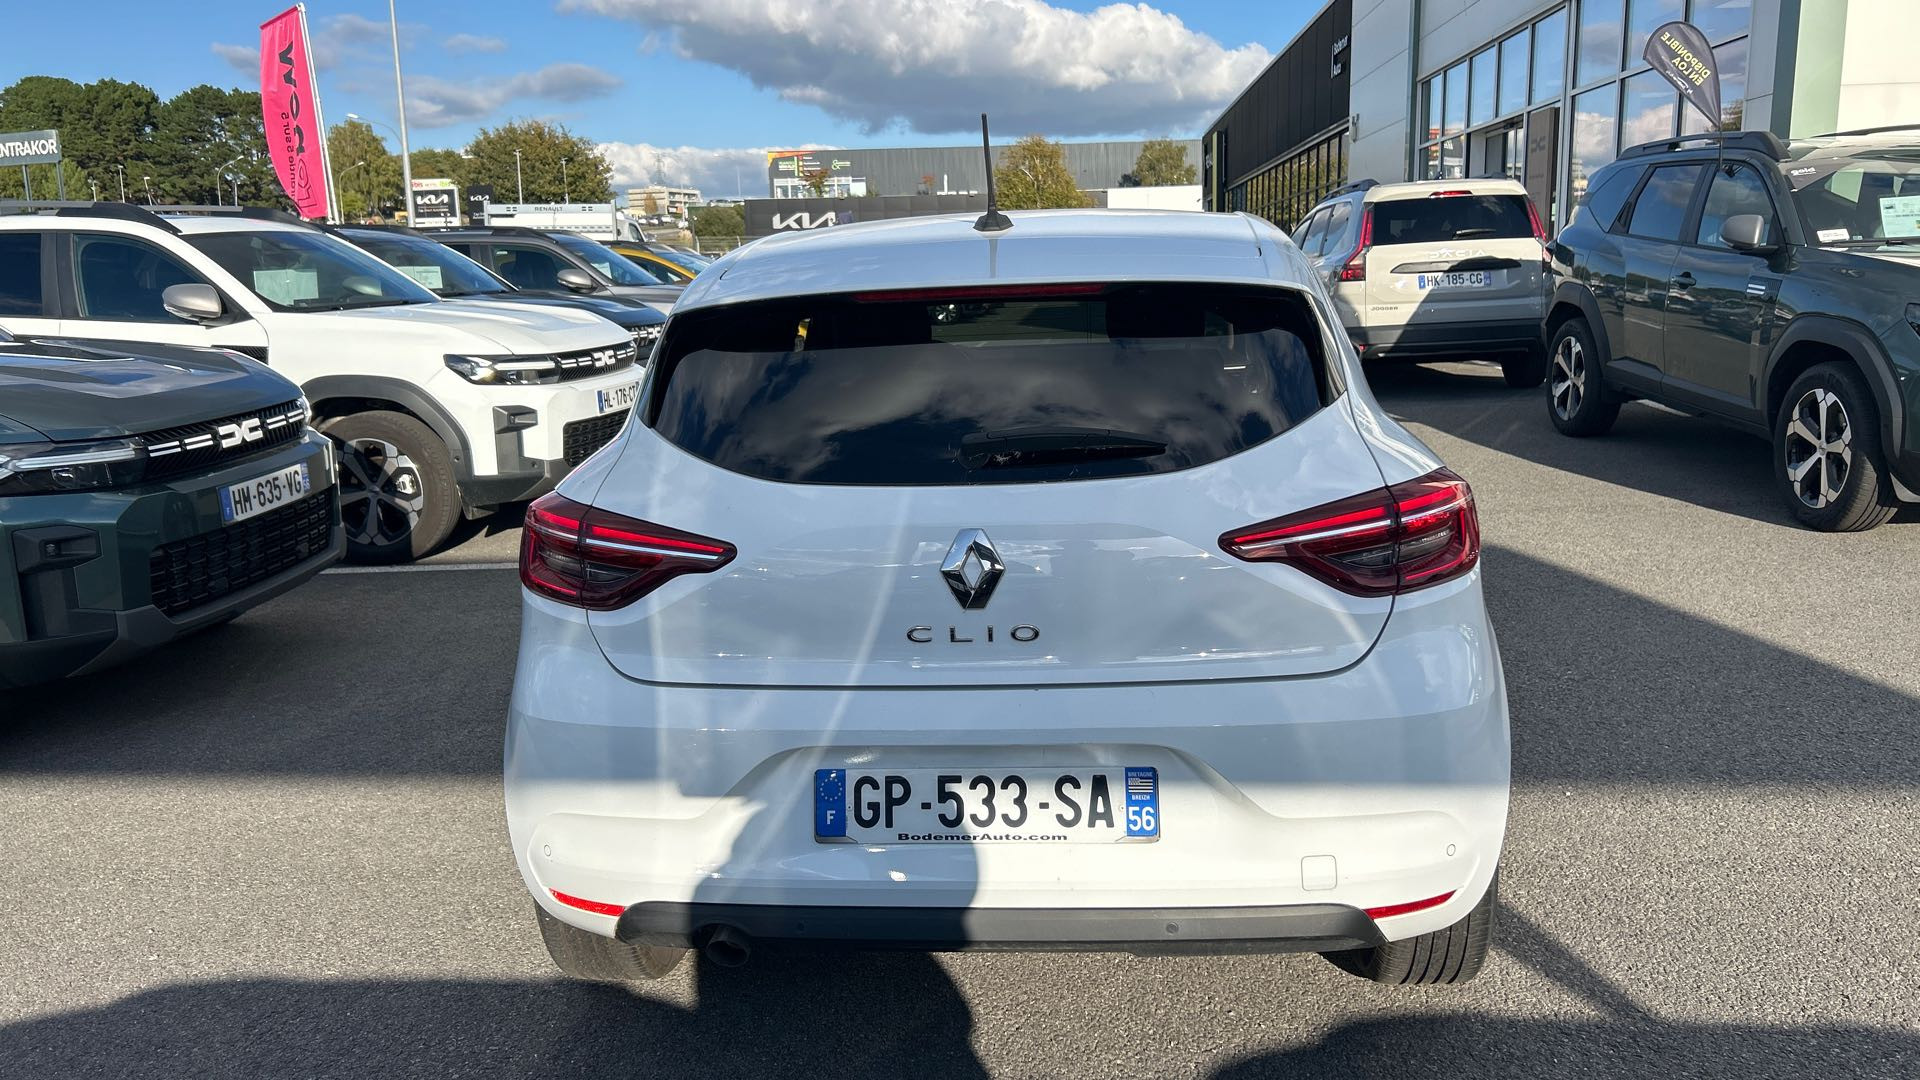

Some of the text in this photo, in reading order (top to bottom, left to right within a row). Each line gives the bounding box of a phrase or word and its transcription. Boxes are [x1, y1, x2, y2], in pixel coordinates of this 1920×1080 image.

[232, 470, 302, 516] HM-635-VG
[906, 623, 1041, 643] CLIO
[853, 774, 1115, 829] GP-533-SA
[826, 810, 836, 825] F
[1128, 806, 1155, 831] 56
[897, 832, 1068, 842] BodemerAuto.com
